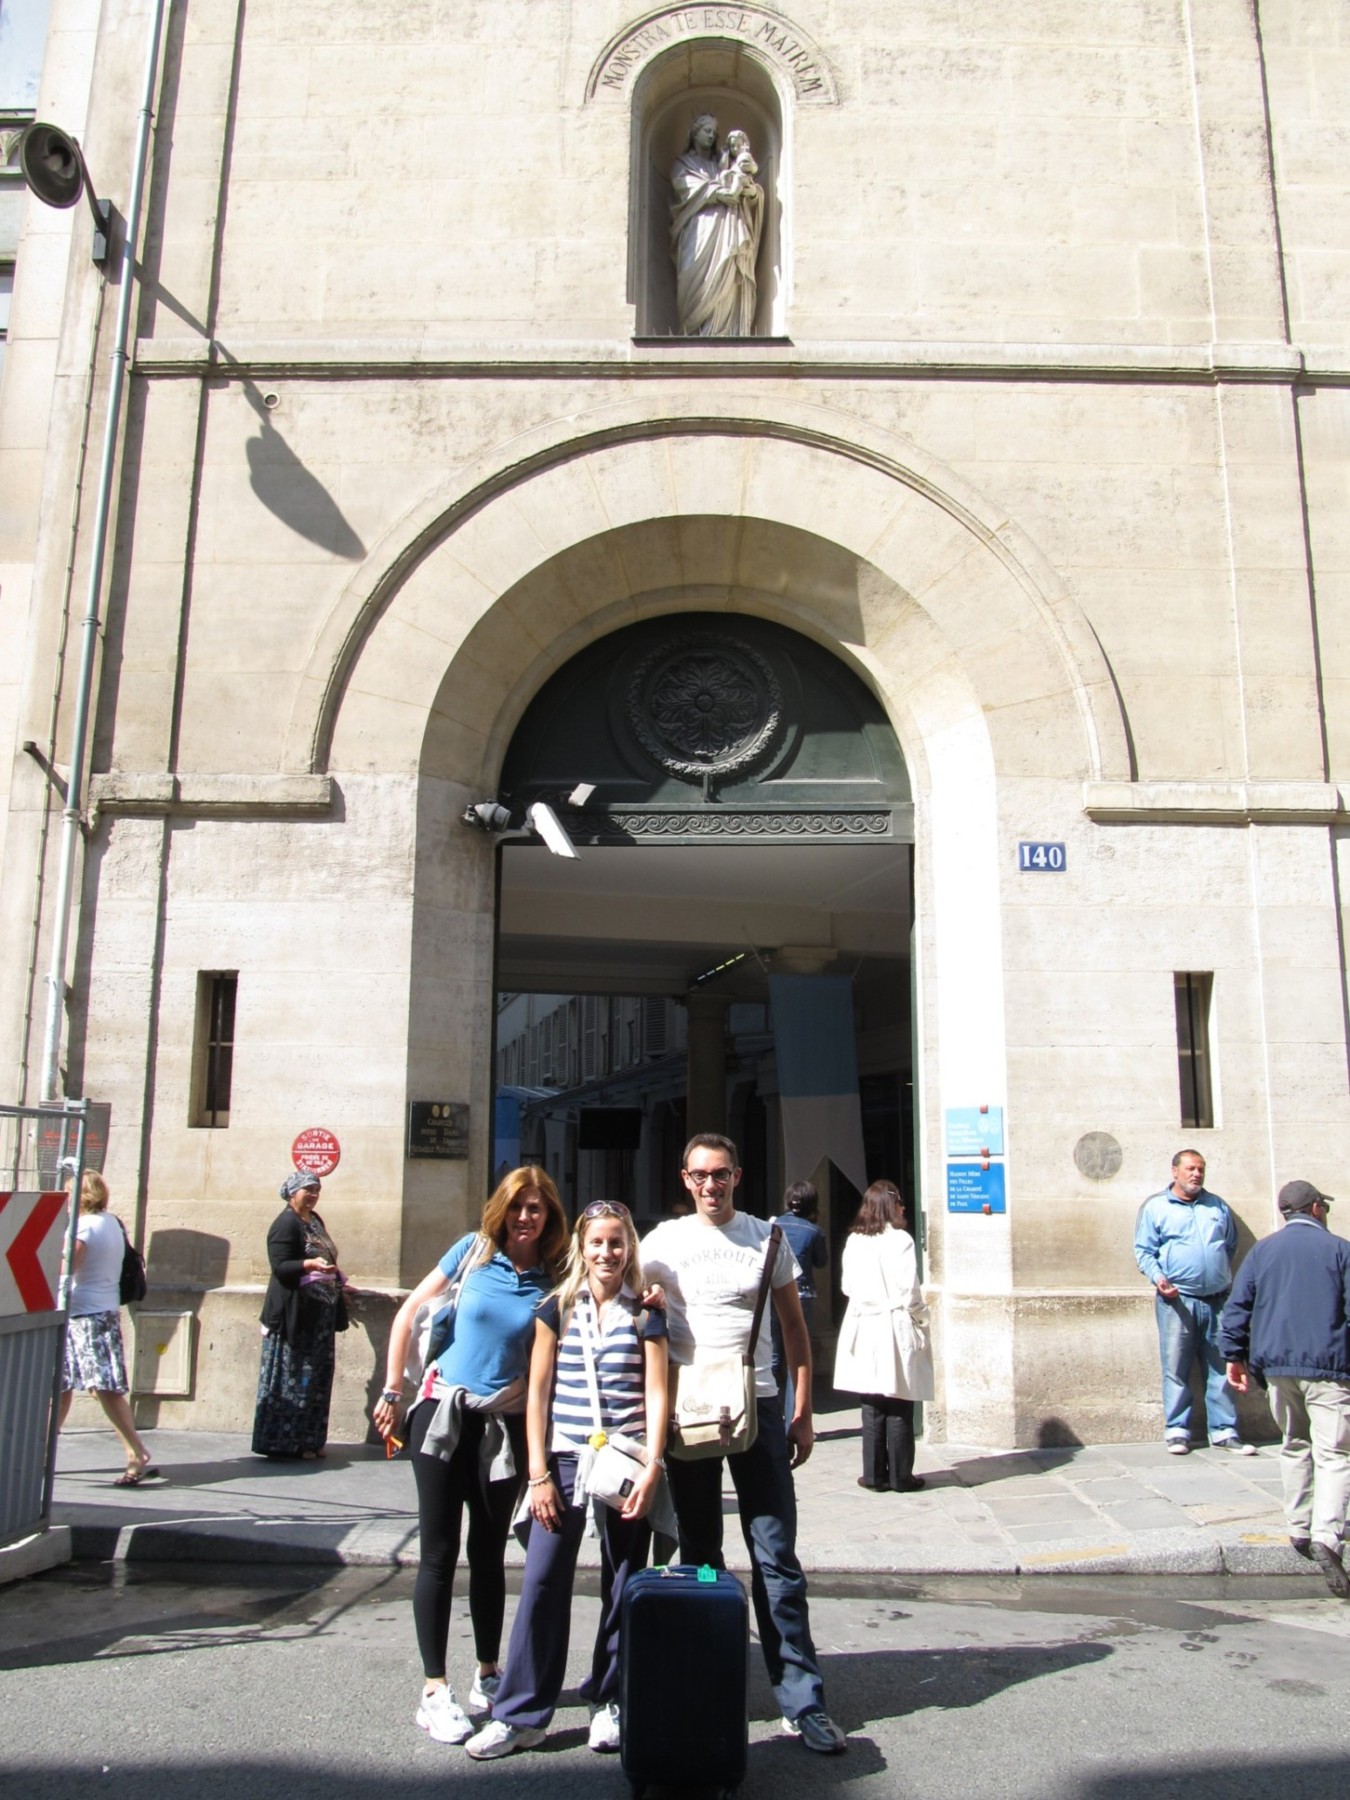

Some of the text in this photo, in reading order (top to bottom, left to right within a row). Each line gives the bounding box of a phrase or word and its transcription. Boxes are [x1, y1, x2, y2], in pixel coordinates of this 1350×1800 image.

[601, 9, 823, 93] MONSTRA TE ESSE MATREM
[1022, 845, 1062, 868] 140
[297, 1142, 334, 1150] GARAGE
[301, 1130, 331, 1141] SORTIE
[680, 1248, 757, 1269] WORKOUT
